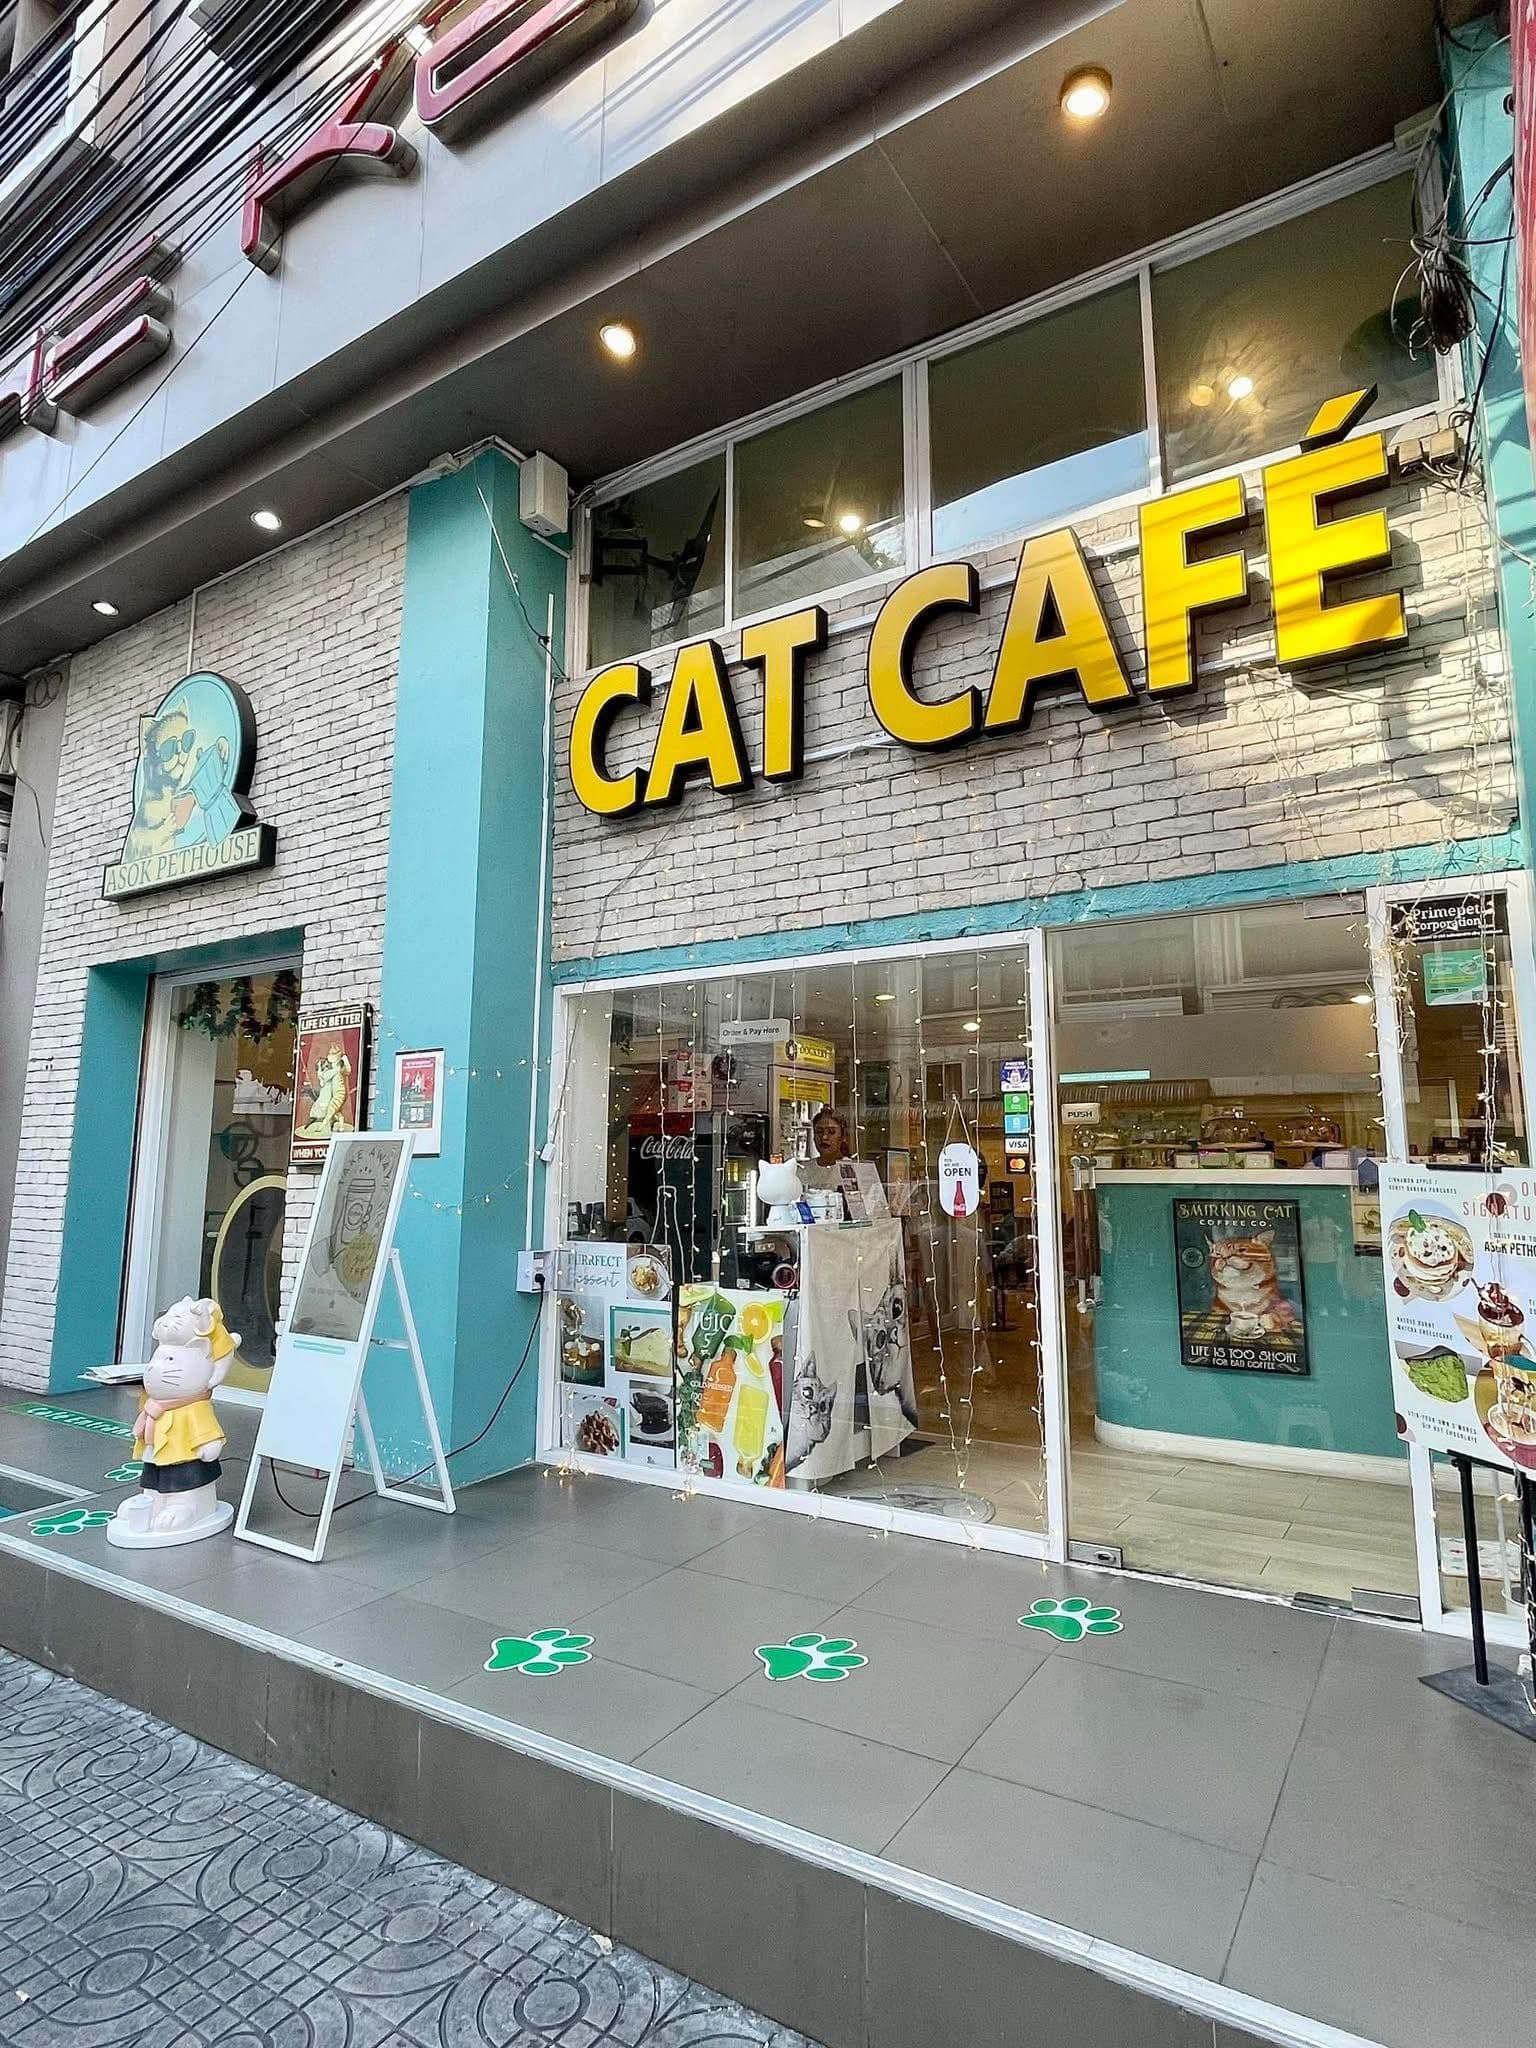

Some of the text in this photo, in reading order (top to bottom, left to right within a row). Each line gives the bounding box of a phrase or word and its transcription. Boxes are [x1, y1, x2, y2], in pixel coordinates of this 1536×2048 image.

[569, 387, 1406, 818] CAT CAFÉ
[105, 831, 258, 893] ASOK PETHOUSE
[1411, 904, 1482, 921] Primepet
[301, 1013, 362, 1031] LIFE IS BETTER
[749, 1027, 762, 1037] Pay
[763, 1026, 780, 1034] Here
[1067, 1110, 1093, 1118] PUSH
[1008, 1140, 1028, 1149] VISA
[293, 1148, 313, 1158] WHEN
[943, 1167, 972, 1177] OPEN
[1178, 1203, 1293, 1221] SMIRKING CAT
[1199, 1219, 1246, 1227] COFFEE
[1190, 1345, 1298, 1364] LIFE IS TOO SHORT
[1212, 1358, 1277, 1370] FOR BAD COFFEE
